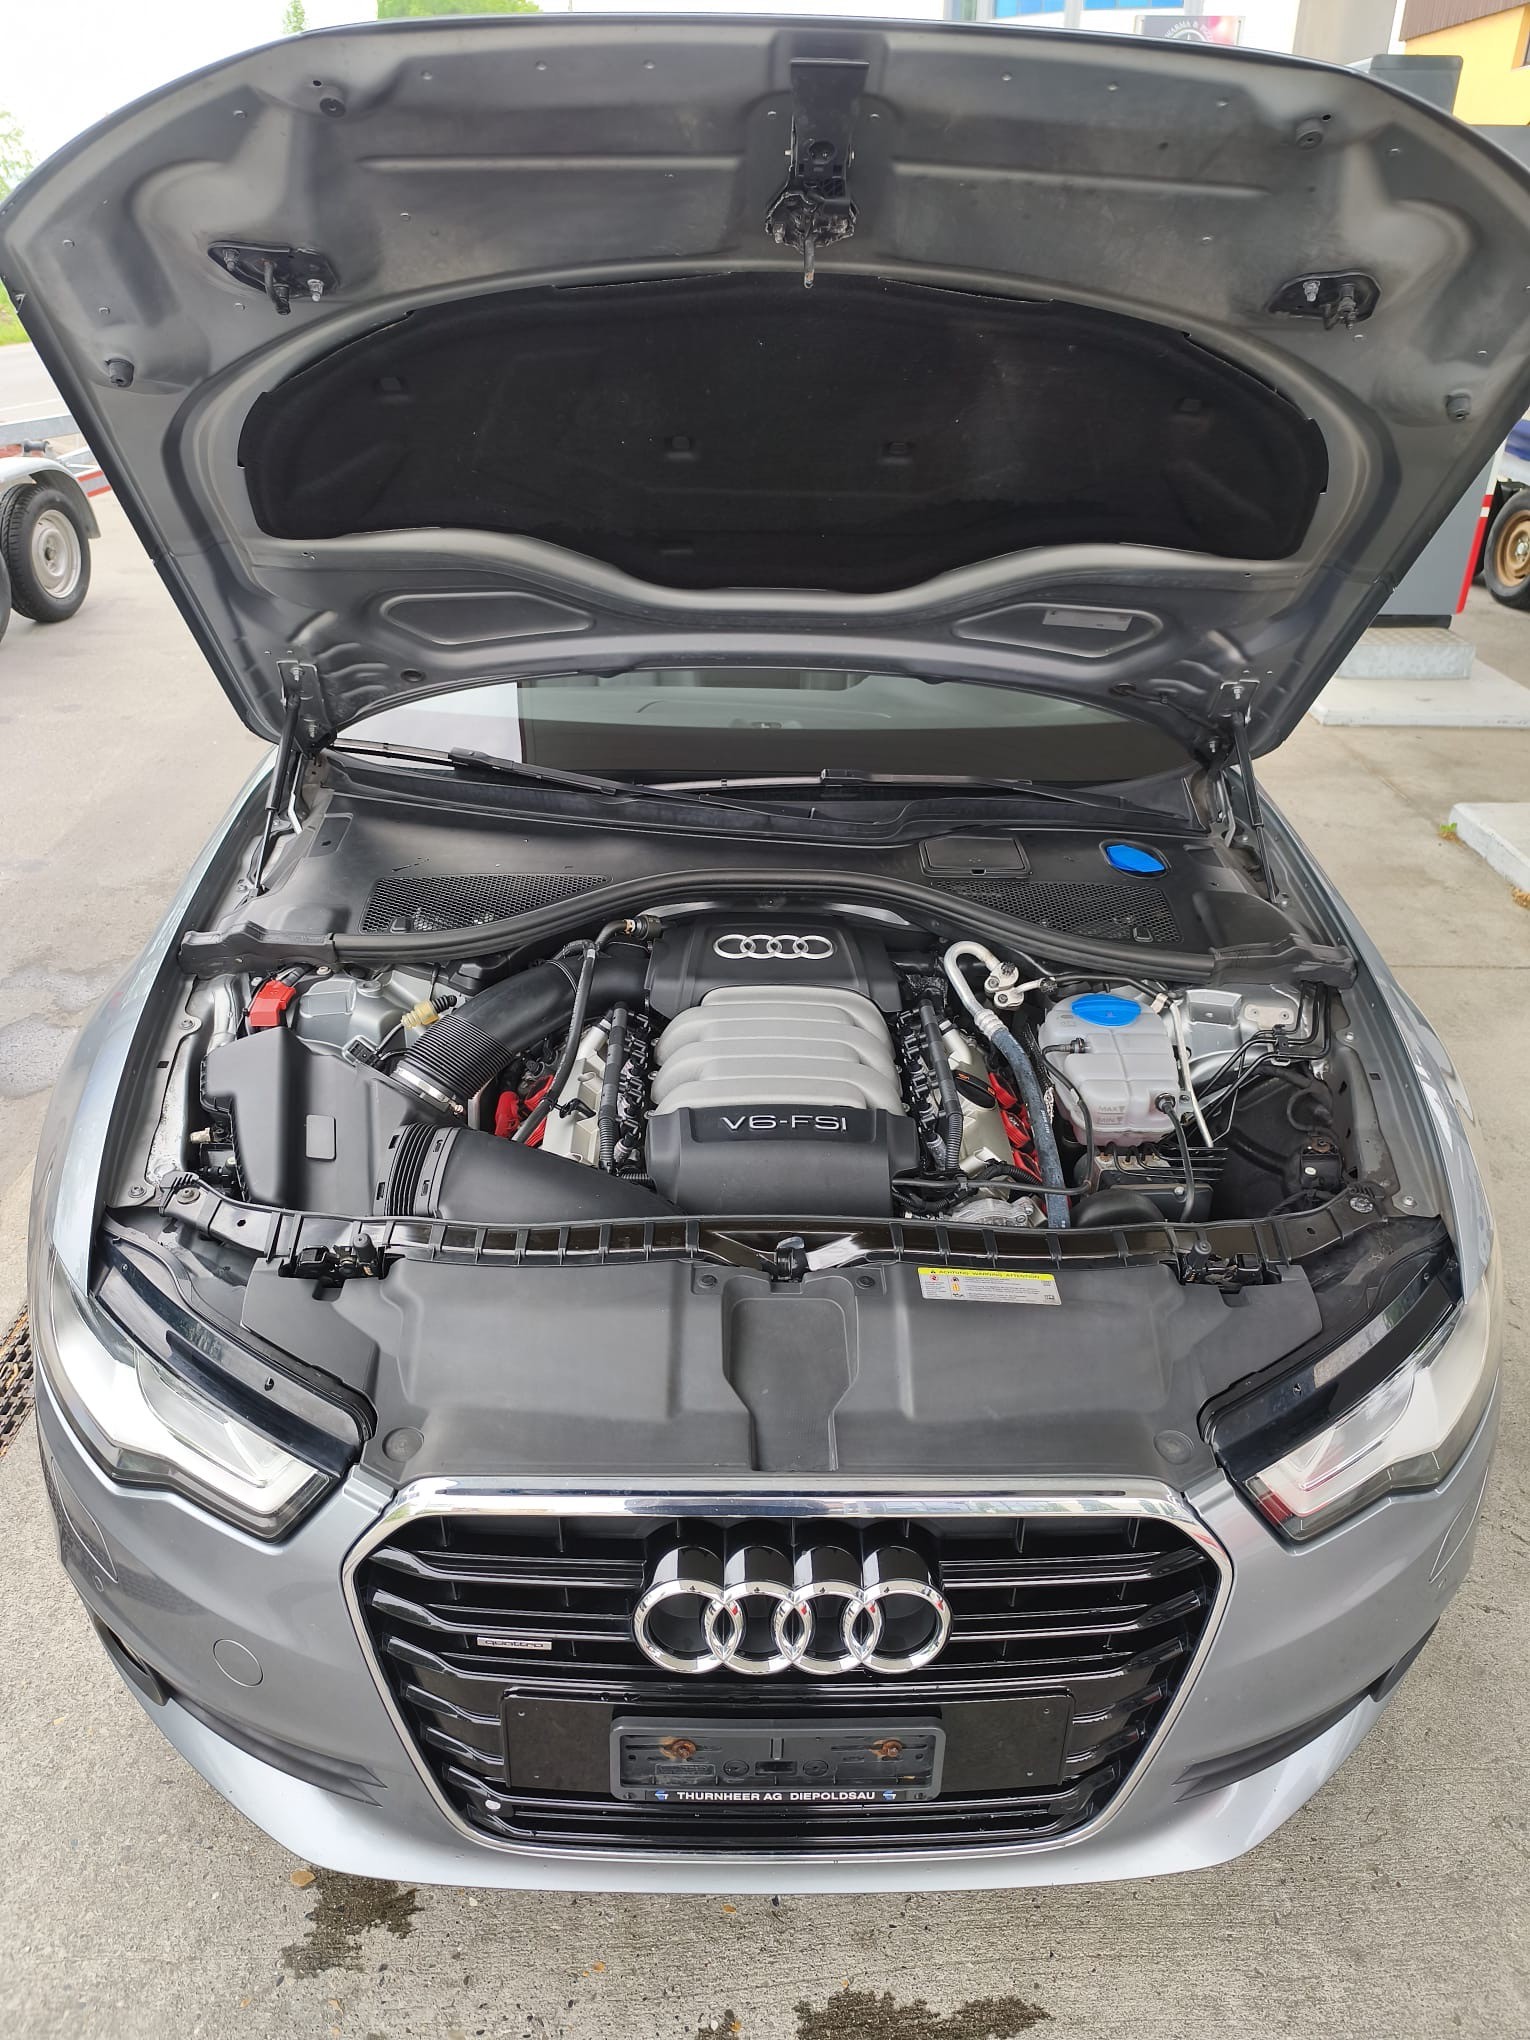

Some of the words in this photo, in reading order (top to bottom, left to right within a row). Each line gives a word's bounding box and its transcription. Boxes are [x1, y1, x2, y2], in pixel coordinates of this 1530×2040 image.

[720, 1114, 847, 1132] V6-FSI
[485, 1640, 544, 1648] quattro
[677, 1791, 761, 1801] THURNHEER
[763, 1791, 783, 1802] AG
[789, 1791, 876, 1801] DIEPOLDSAU
